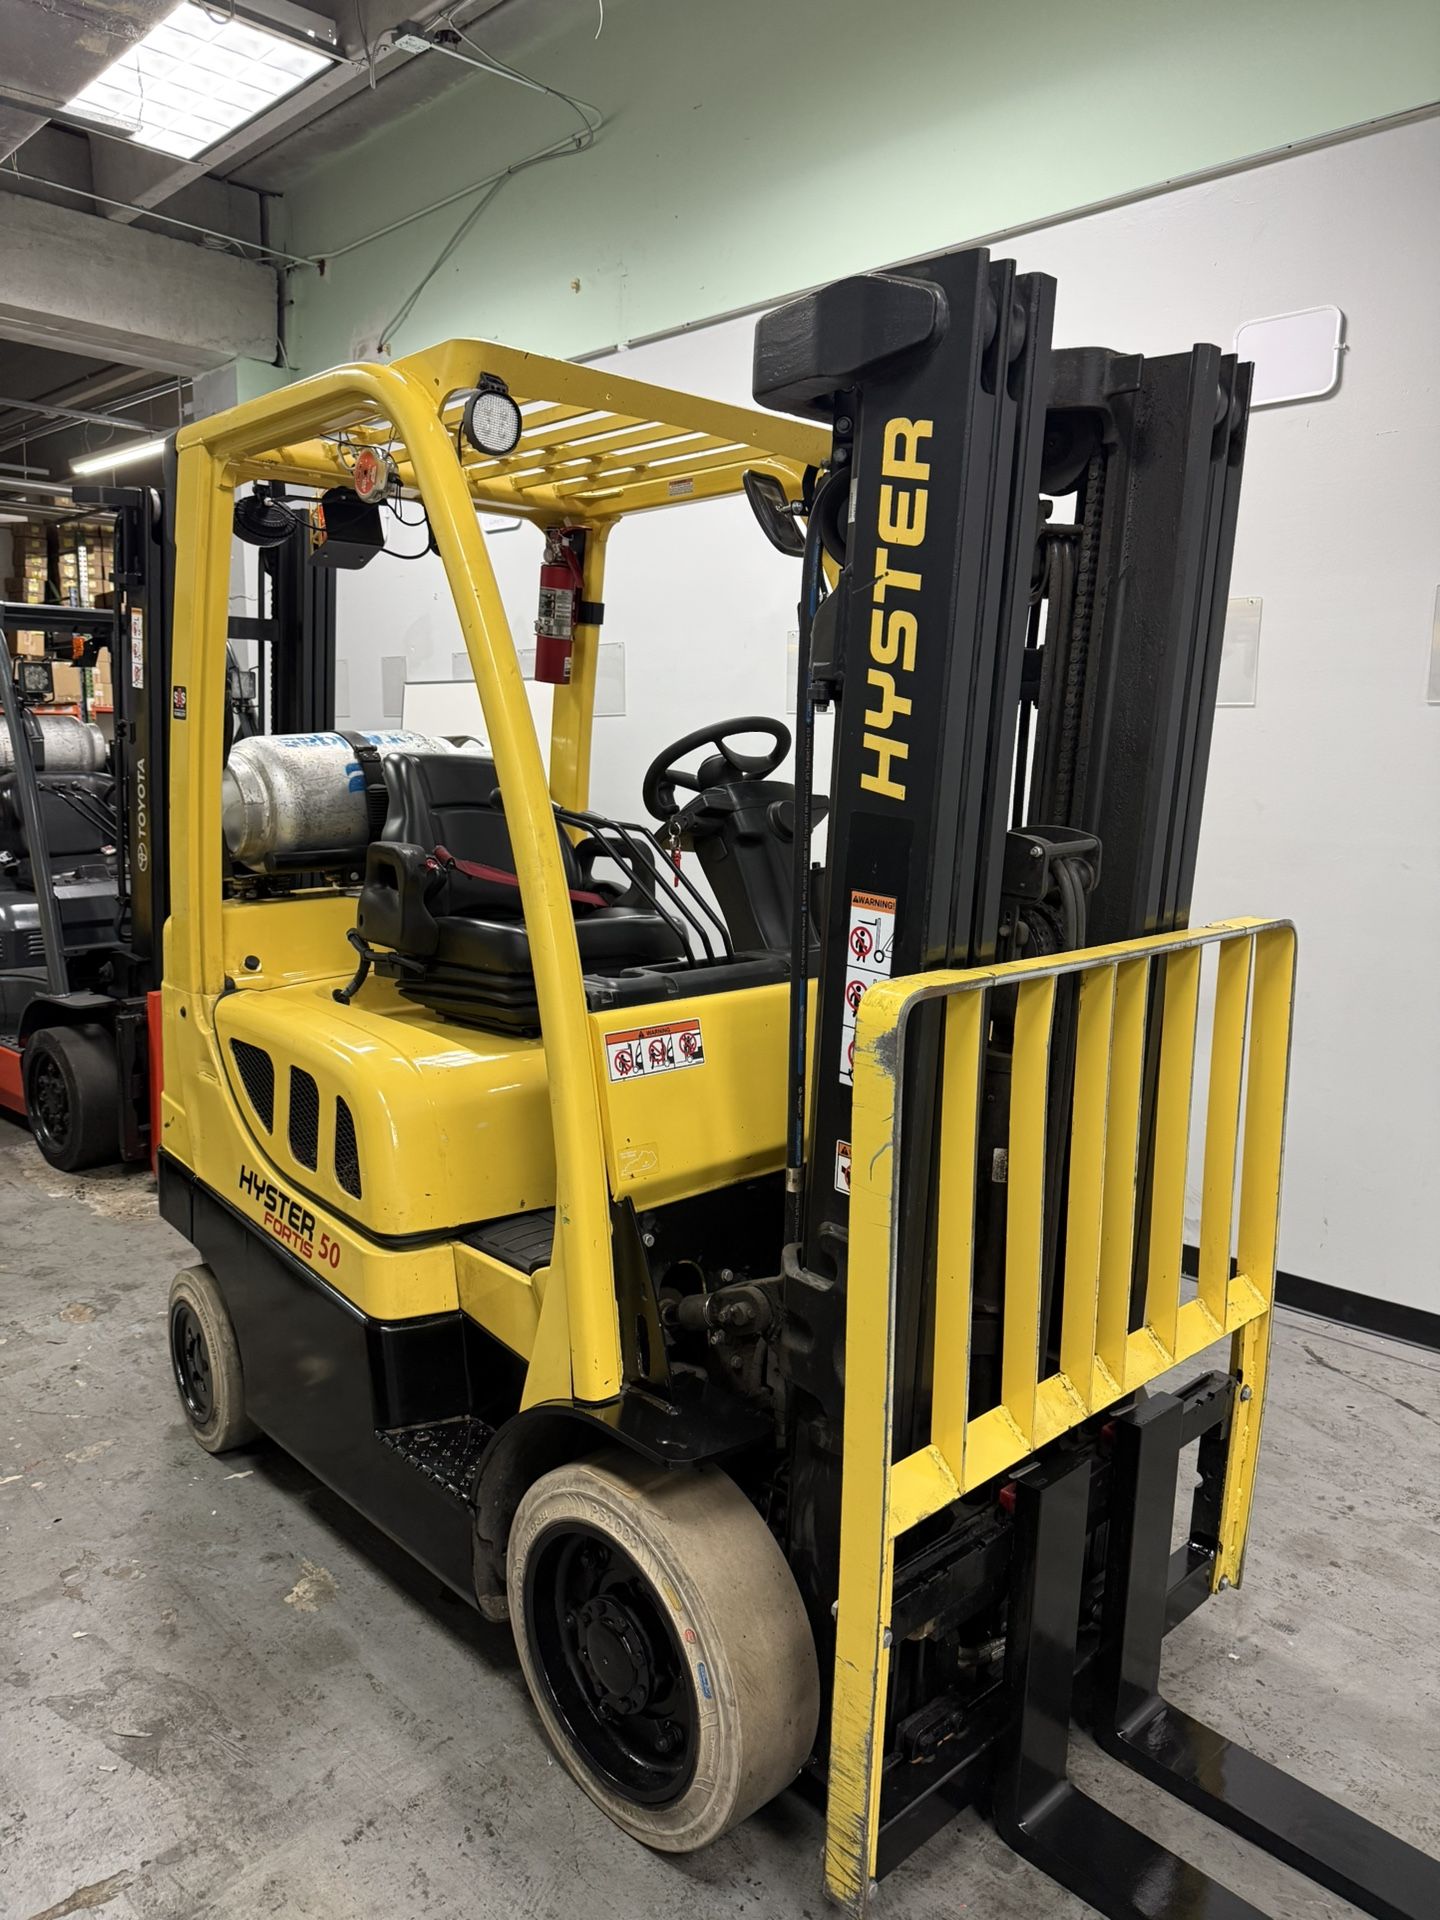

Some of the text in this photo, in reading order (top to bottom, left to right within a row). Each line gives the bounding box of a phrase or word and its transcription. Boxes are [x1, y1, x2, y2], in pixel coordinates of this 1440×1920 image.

[861, 416, 933, 801] HYSTER
[137, 757, 146, 838] TOYOTA
[646, 1027, 671, 1037] WARNING
[239, 1164, 341, 1269] HYSTER 50
[264, 1211, 314, 1260] FORTIS
